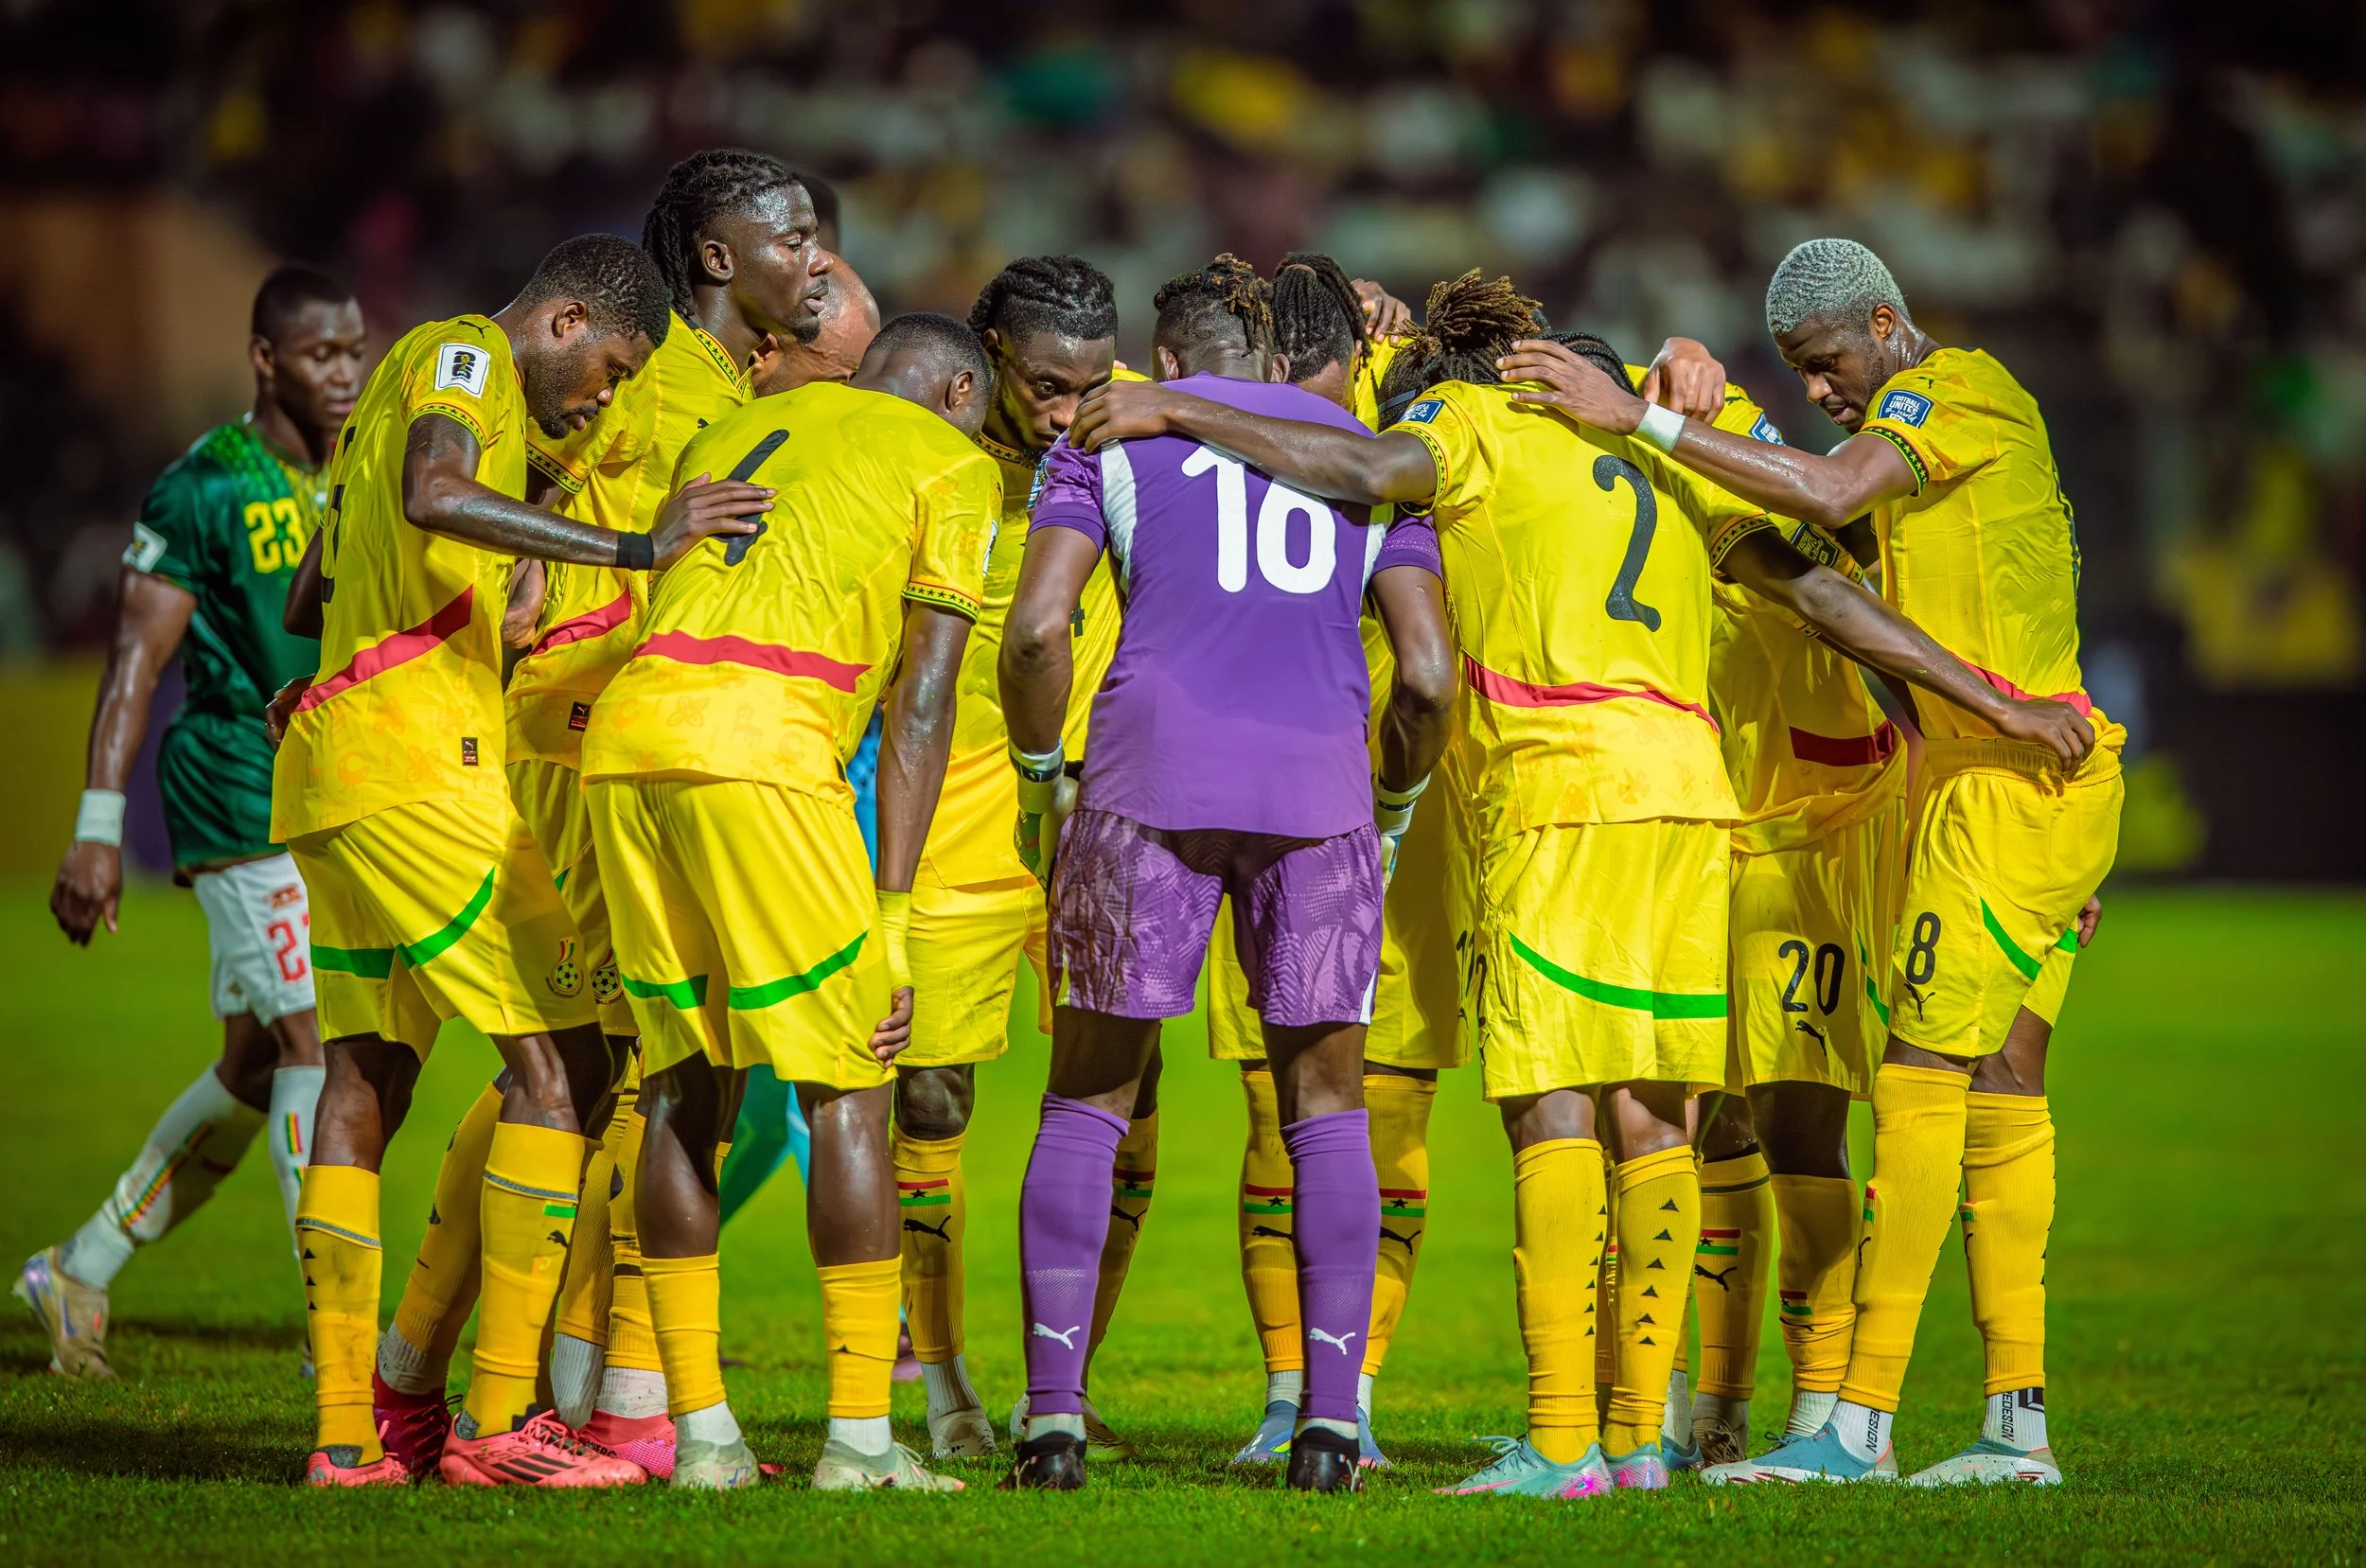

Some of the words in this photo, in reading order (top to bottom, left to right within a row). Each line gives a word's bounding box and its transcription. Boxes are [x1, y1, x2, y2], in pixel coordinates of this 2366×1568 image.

[1889, 400, 1918, 415] UNITES
[1893, 395, 1920, 410] FOOTBALL
[243, 498, 307, 574] 23
[1181, 445, 1336, 593] 16
[1593, 454, 1662, 632] 2
[1778, 940, 1845, 1016] 20
[1906, 911, 1941, 985] 8
[1864, 1408, 1880, 1453] ESIGN
